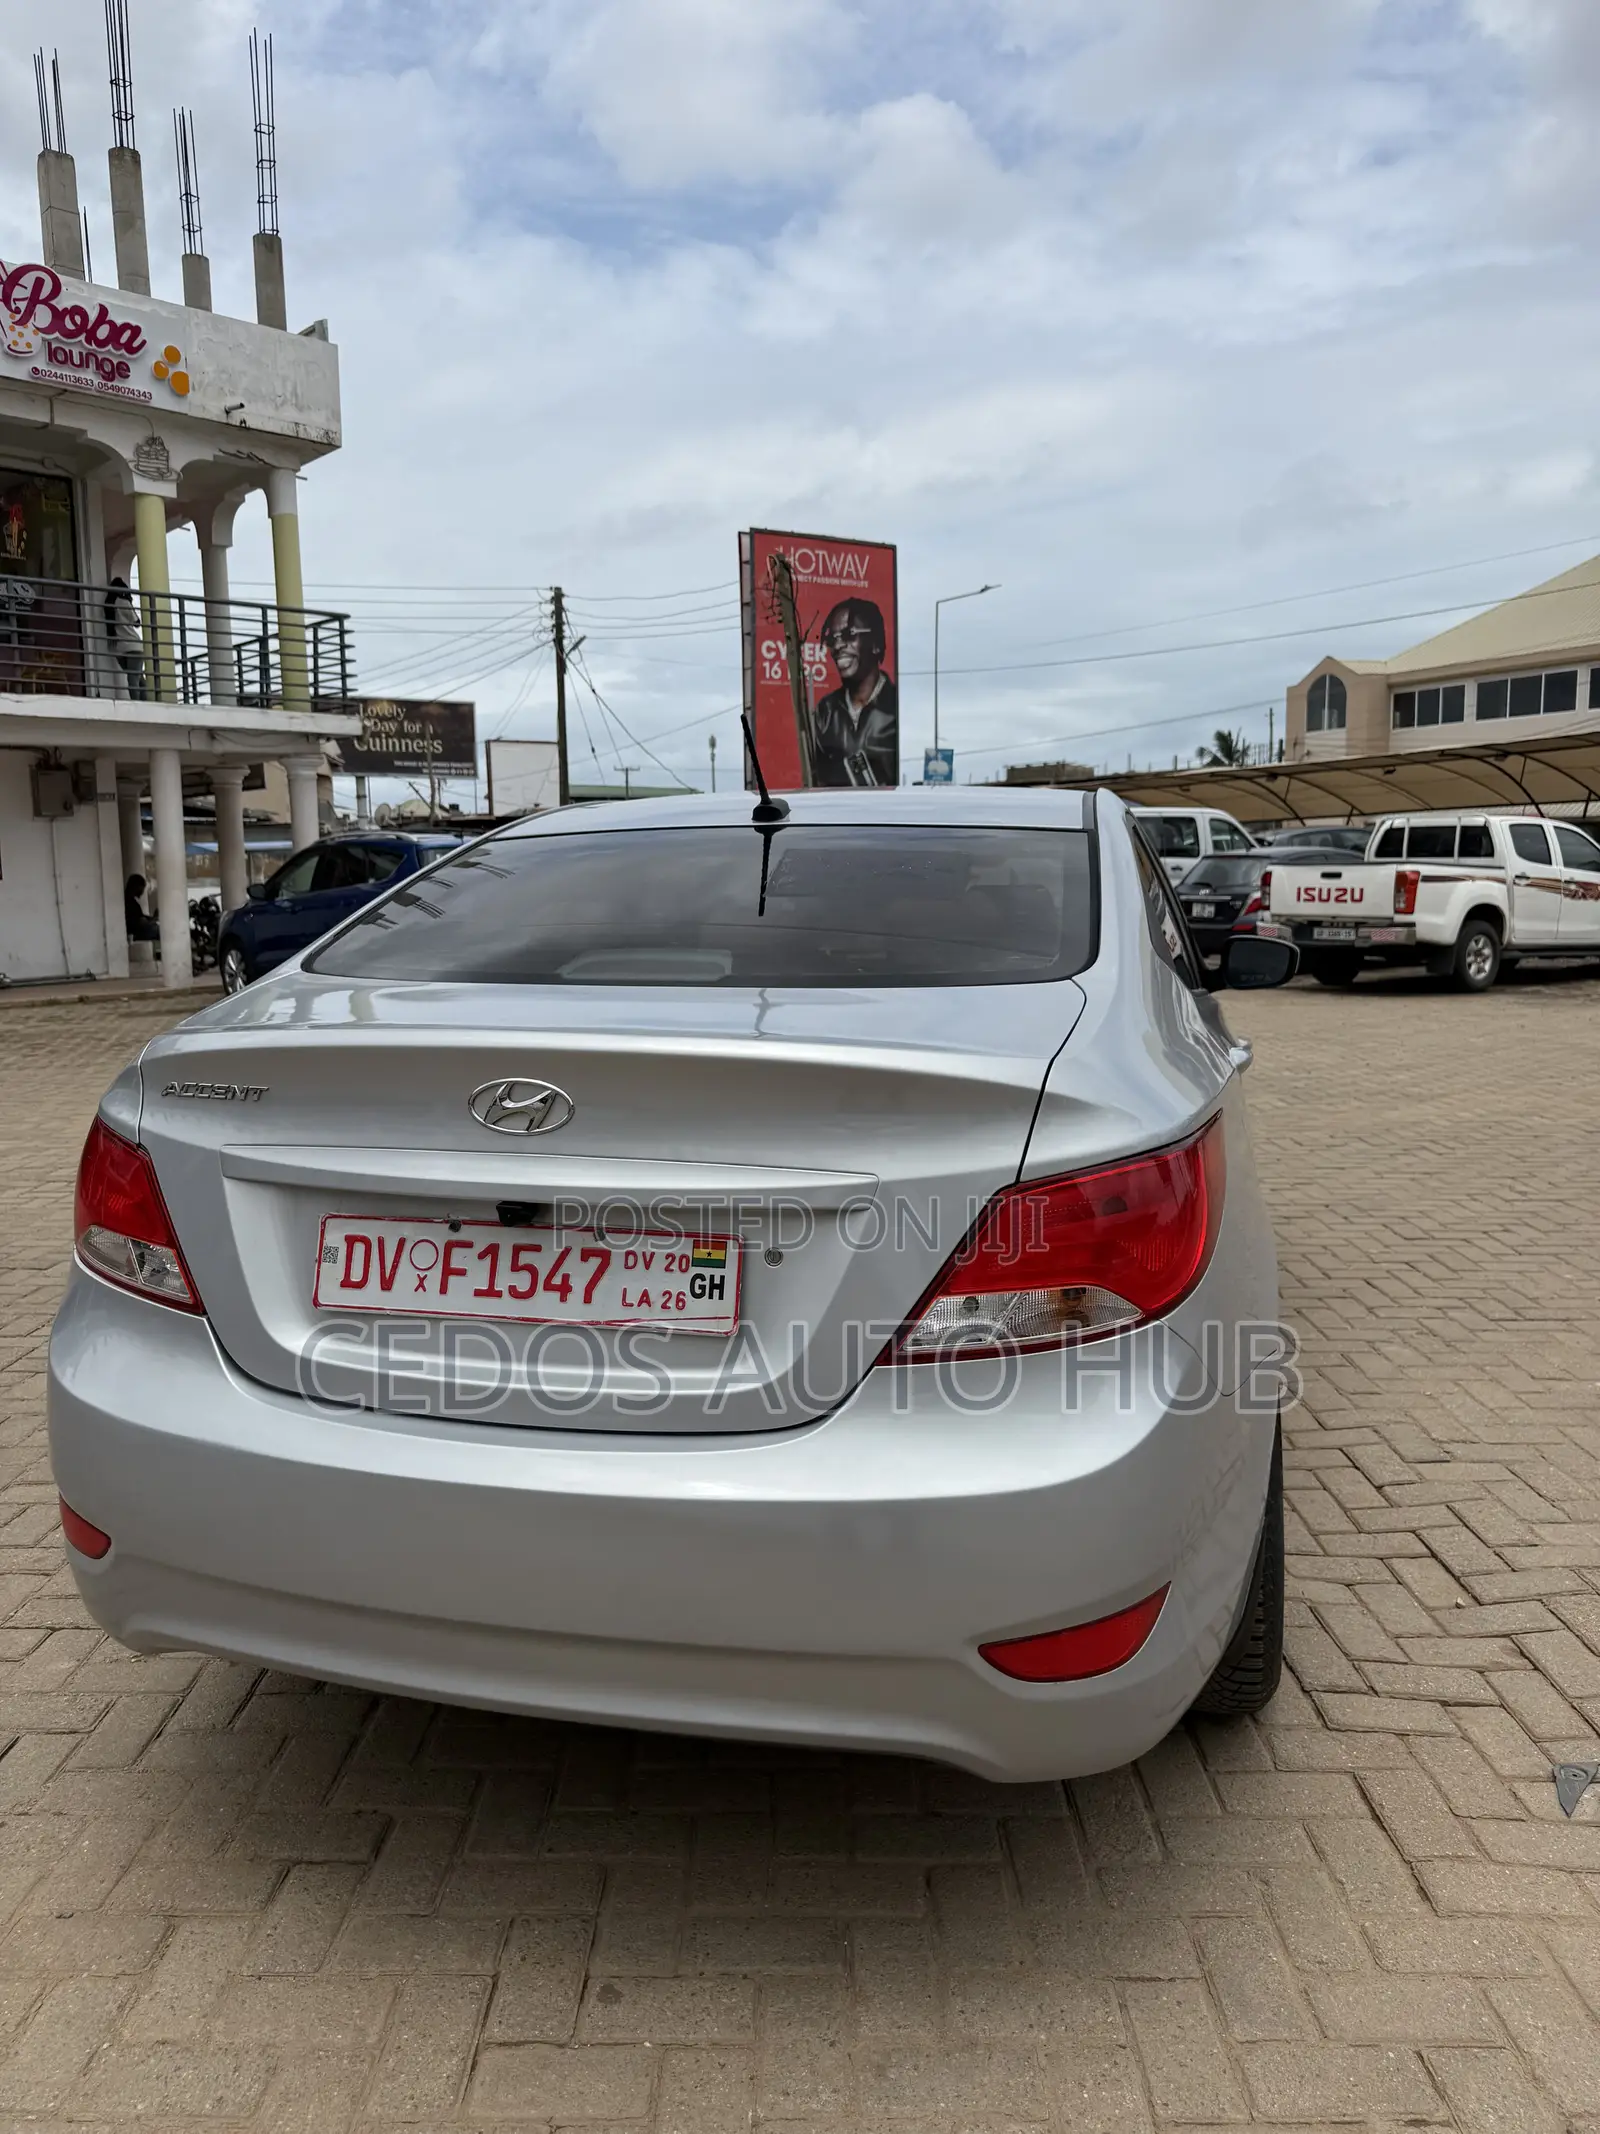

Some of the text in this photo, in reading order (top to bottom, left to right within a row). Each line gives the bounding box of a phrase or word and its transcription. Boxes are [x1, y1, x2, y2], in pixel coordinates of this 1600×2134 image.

[1, 263, 147, 355] Boba
[46, 340, 131, 381] lounge
[40, 368, 153, 400] 0244113633 0549074343
[761, 640, 827, 662] CYER
[763, 661, 782, 680] 16
[358, 703, 406, 721] Lovely
[370, 718, 398, 734] Day
[404, 720, 422, 733] for
[1296, 886, 1364, 903] ISUZU
[161, 1081, 269, 1102] ACCENT
[340, 1234, 612, 1305] DV F1547
[624, 1250, 690, 1274] DV 20
[621, 1287, 687, 1311] LA 26
[689, 1273, 725, 1301] GH
